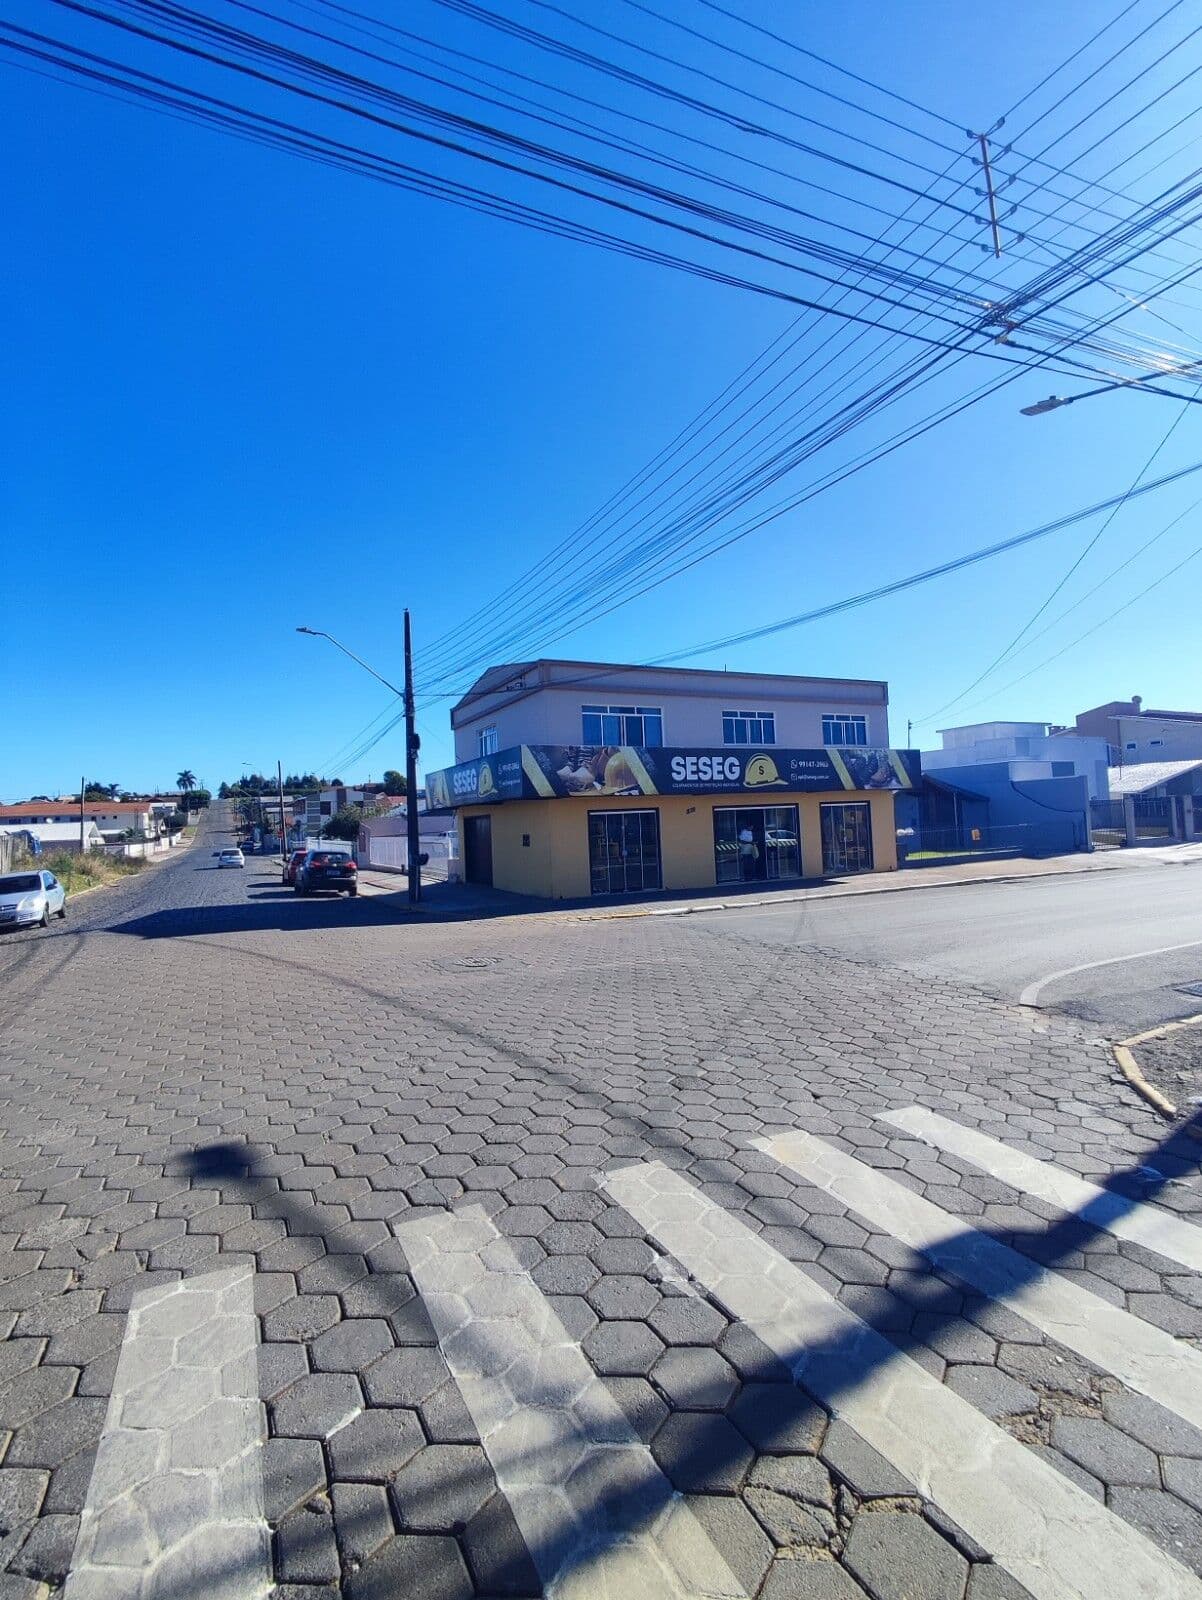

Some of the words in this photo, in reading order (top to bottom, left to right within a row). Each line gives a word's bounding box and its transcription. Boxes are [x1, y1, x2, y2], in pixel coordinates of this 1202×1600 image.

[671, 756, 740, 780] SESEG
[758, 765, 765, 775] S
[453, 768, 477, 794] SESEG
